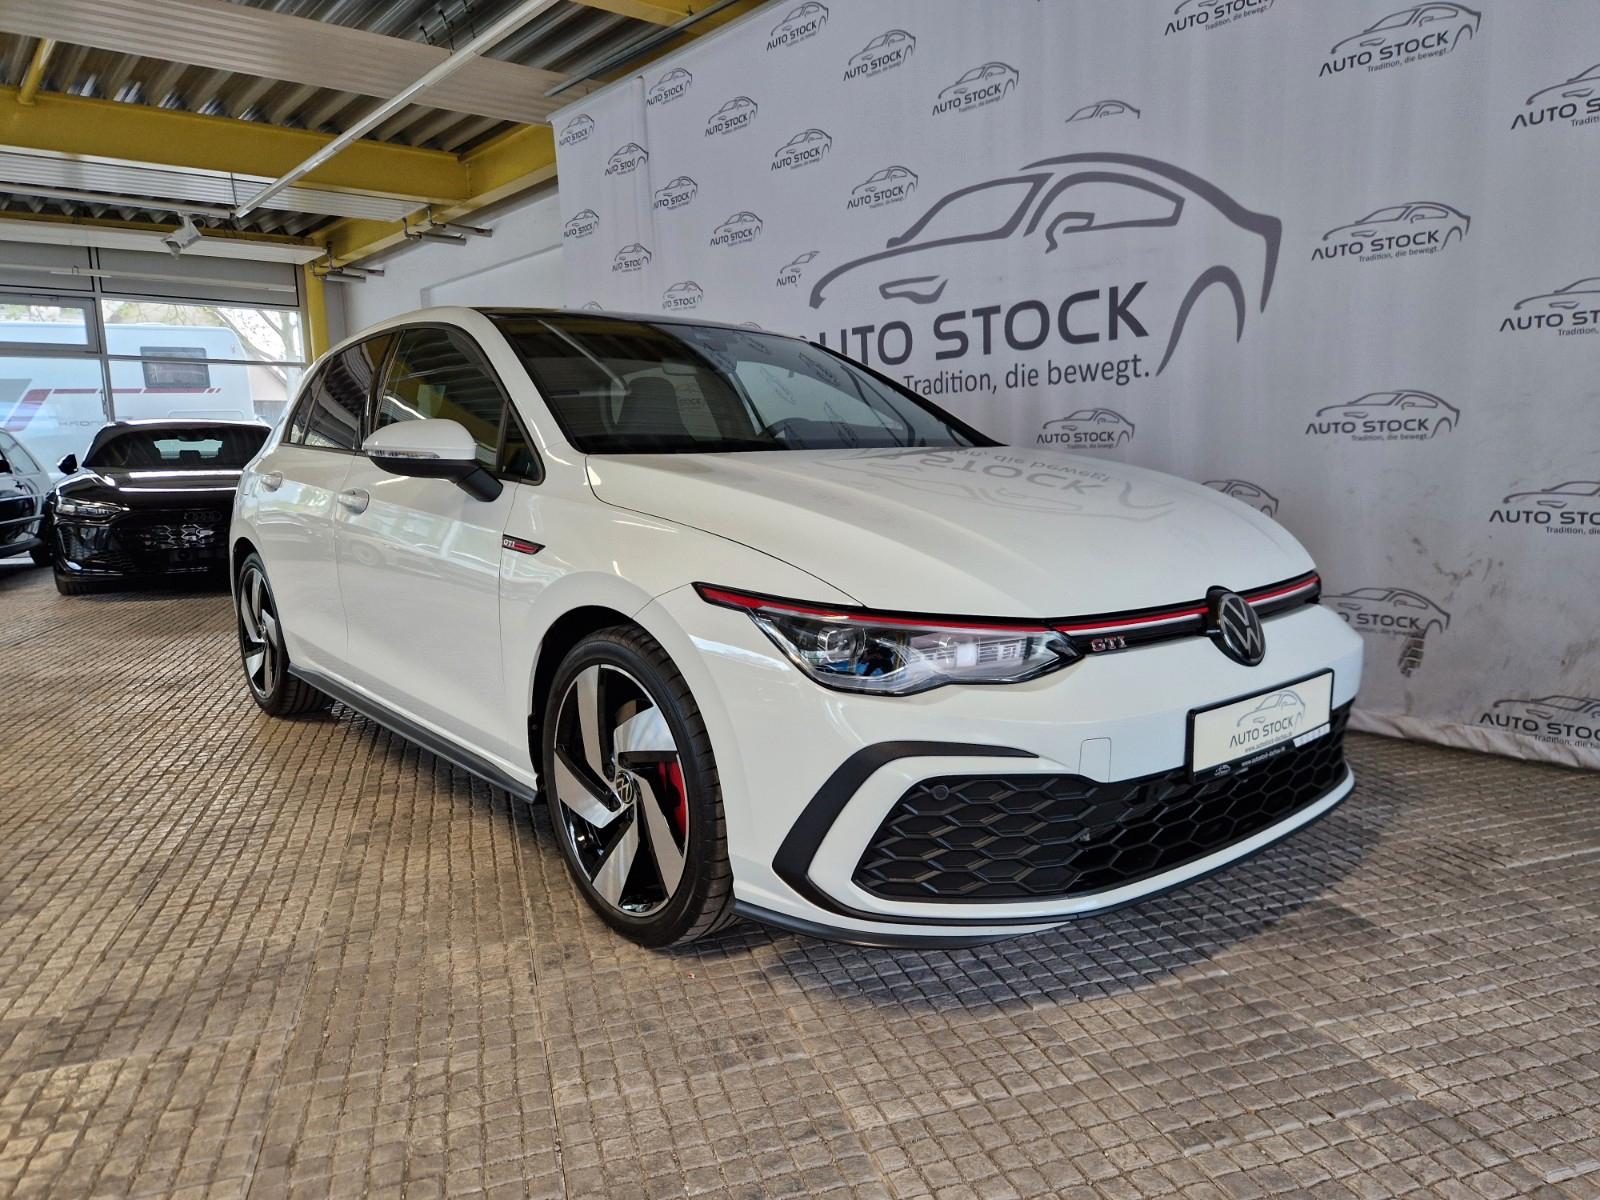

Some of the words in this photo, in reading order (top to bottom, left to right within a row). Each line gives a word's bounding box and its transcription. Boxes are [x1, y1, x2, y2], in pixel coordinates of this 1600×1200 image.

[1164, 11, 1209, 36] AUTO
[1213, 0, 1268, 19] STOC
[766, 33, 788, 51] AUTO
[789, 20, 817, 40] STOCK
[1318, 51, 1372, 78] AUTO
[1379, 30, 1449, 61] STOCK
[842, 63, 868, 81] AUTO
[870, 49, 902, 71] STOCK
[1367, 59, 1402, 73] Tradition,
[1404, 55, 1416, 64] die
[646, 93, 663, 106] AUTO
[663, 82, 684, 100] STOCK
[932, 97, 961, 116] AUTO
[964, 83, 1002, 105] STOCK
[704, 123, 723, 137] AUTO
[724, 113, 748, 130] STOCK
[1510, 103, 1577, 130] AUTO
[571, 127, 588, 141] STOCK
[770, 157, 792, 171] AUTO
[793, 146, 821, 163] STOCK
[604, 163, 619, 176] AUTO
[670, 190, 690, 205] STOCK
[846, 193, 872, 210] AUTO
[873, 185, 904, 201] STOCK
[563, 228, 577, 239] AUTO
[578, 222, 593, 235] STOCK
[710, 235, 729, 247] AUTO
[730, 228, 753, 241] STOCK
[1311, 241, 1363, 262] AUTO
[1370, 229, 1440, 252] STOCK
[1358, 252, 1393, 263] Tradition,
[1395, 249, 1407, 258] die
[776, 275, 797, 288] AUTO
[672, 296, 696, 307] STOCK
[932, 281, 1150, 361] STOCK
[1499, 313, 1564, 332] AUTO
[903, 370, 998, 396] Tradition,
[1004, 363, 1039, 389] die
[1047, 354, 1150, 387] bewegt.
[1305, 421, 1356, 435] AUTO
[1362, 418, 1429, 433] STOCK
[1036, 432, 1071, 444] AUTO
[1073, 431, 1115, 443] STOCK
[1488, 510, 1551, 524] AUTO
[1545, 526, 1587, 536] Tradition,
[1356, 613, 1421, 630] STOCK
[1091, 634, 1128, 652] GTI
[1480, 712, 1539, 732] AUTO
[1229, 728, 1260, 749] AUTO
[1262, 715, 1294, 737] STOCK
